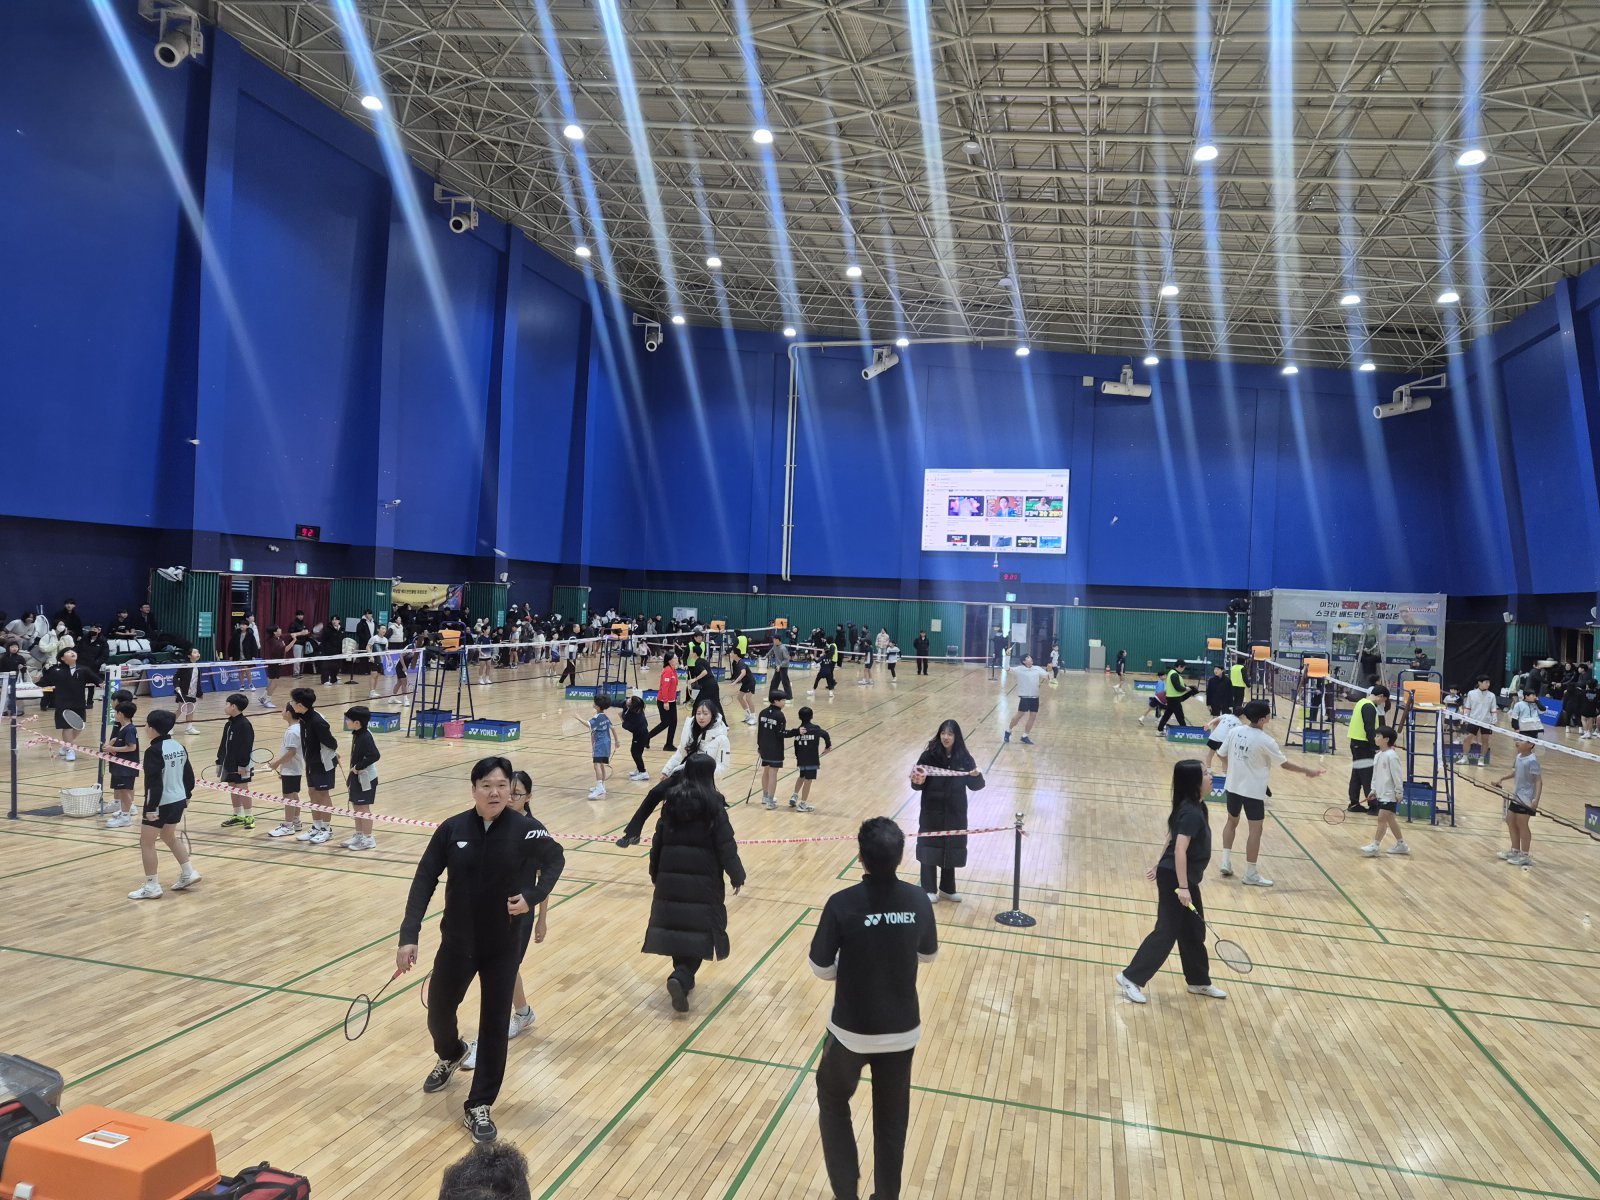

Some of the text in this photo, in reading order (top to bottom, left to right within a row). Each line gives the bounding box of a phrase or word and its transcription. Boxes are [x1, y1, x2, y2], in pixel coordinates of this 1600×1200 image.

[1315, 610, 1338, 618] 스크린
[578, 690, 595, 698] YONEX
[479, 728, 498, 738] YONEX
[524, 829, 550, 840] DYN
[883, 912, 916, 924] YONEX
